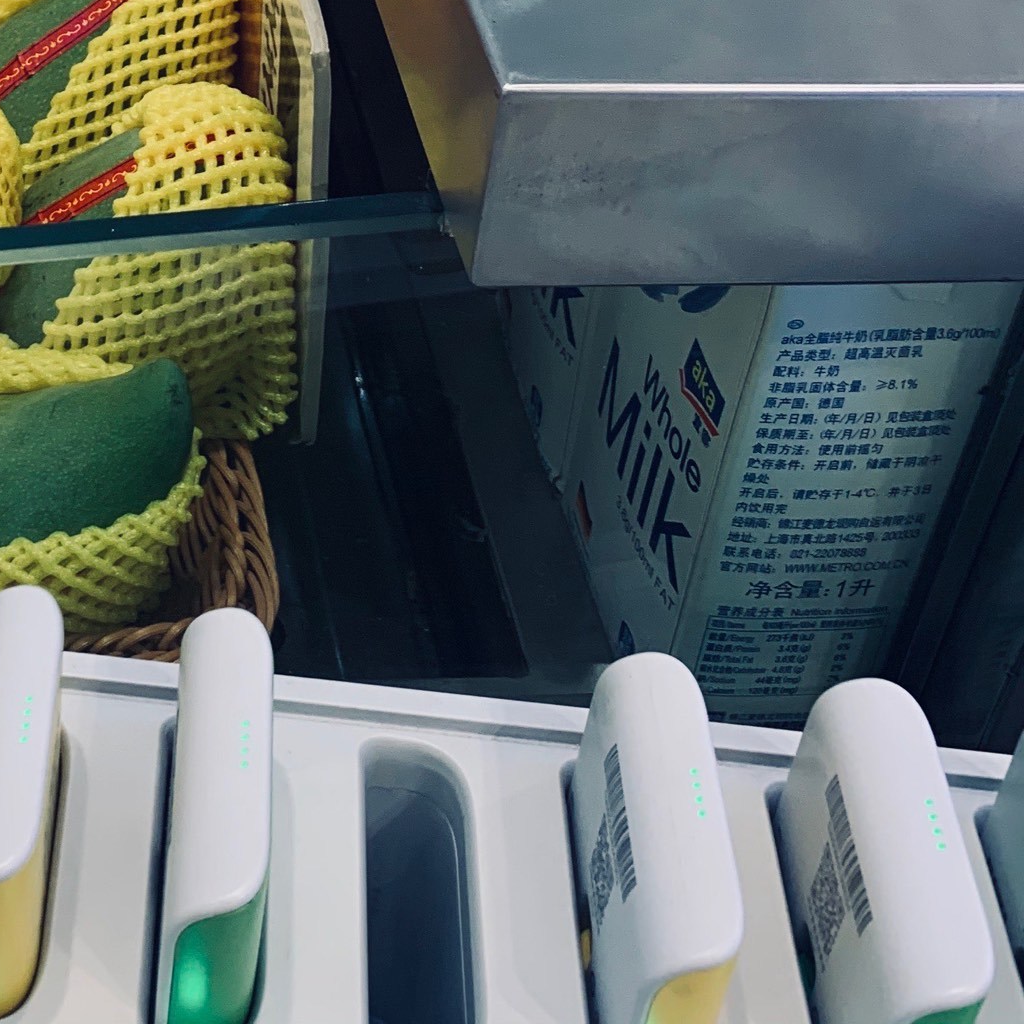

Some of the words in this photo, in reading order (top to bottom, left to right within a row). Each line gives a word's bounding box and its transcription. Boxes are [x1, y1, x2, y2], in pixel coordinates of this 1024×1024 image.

[691, 358, 717, 413] aka
[643, 353, 703, 494] Whole
[596, 334, 694, 596] Milk
[735, 503, 789, 515] 内饮用完
[652, 578, 677, 612] FAT
